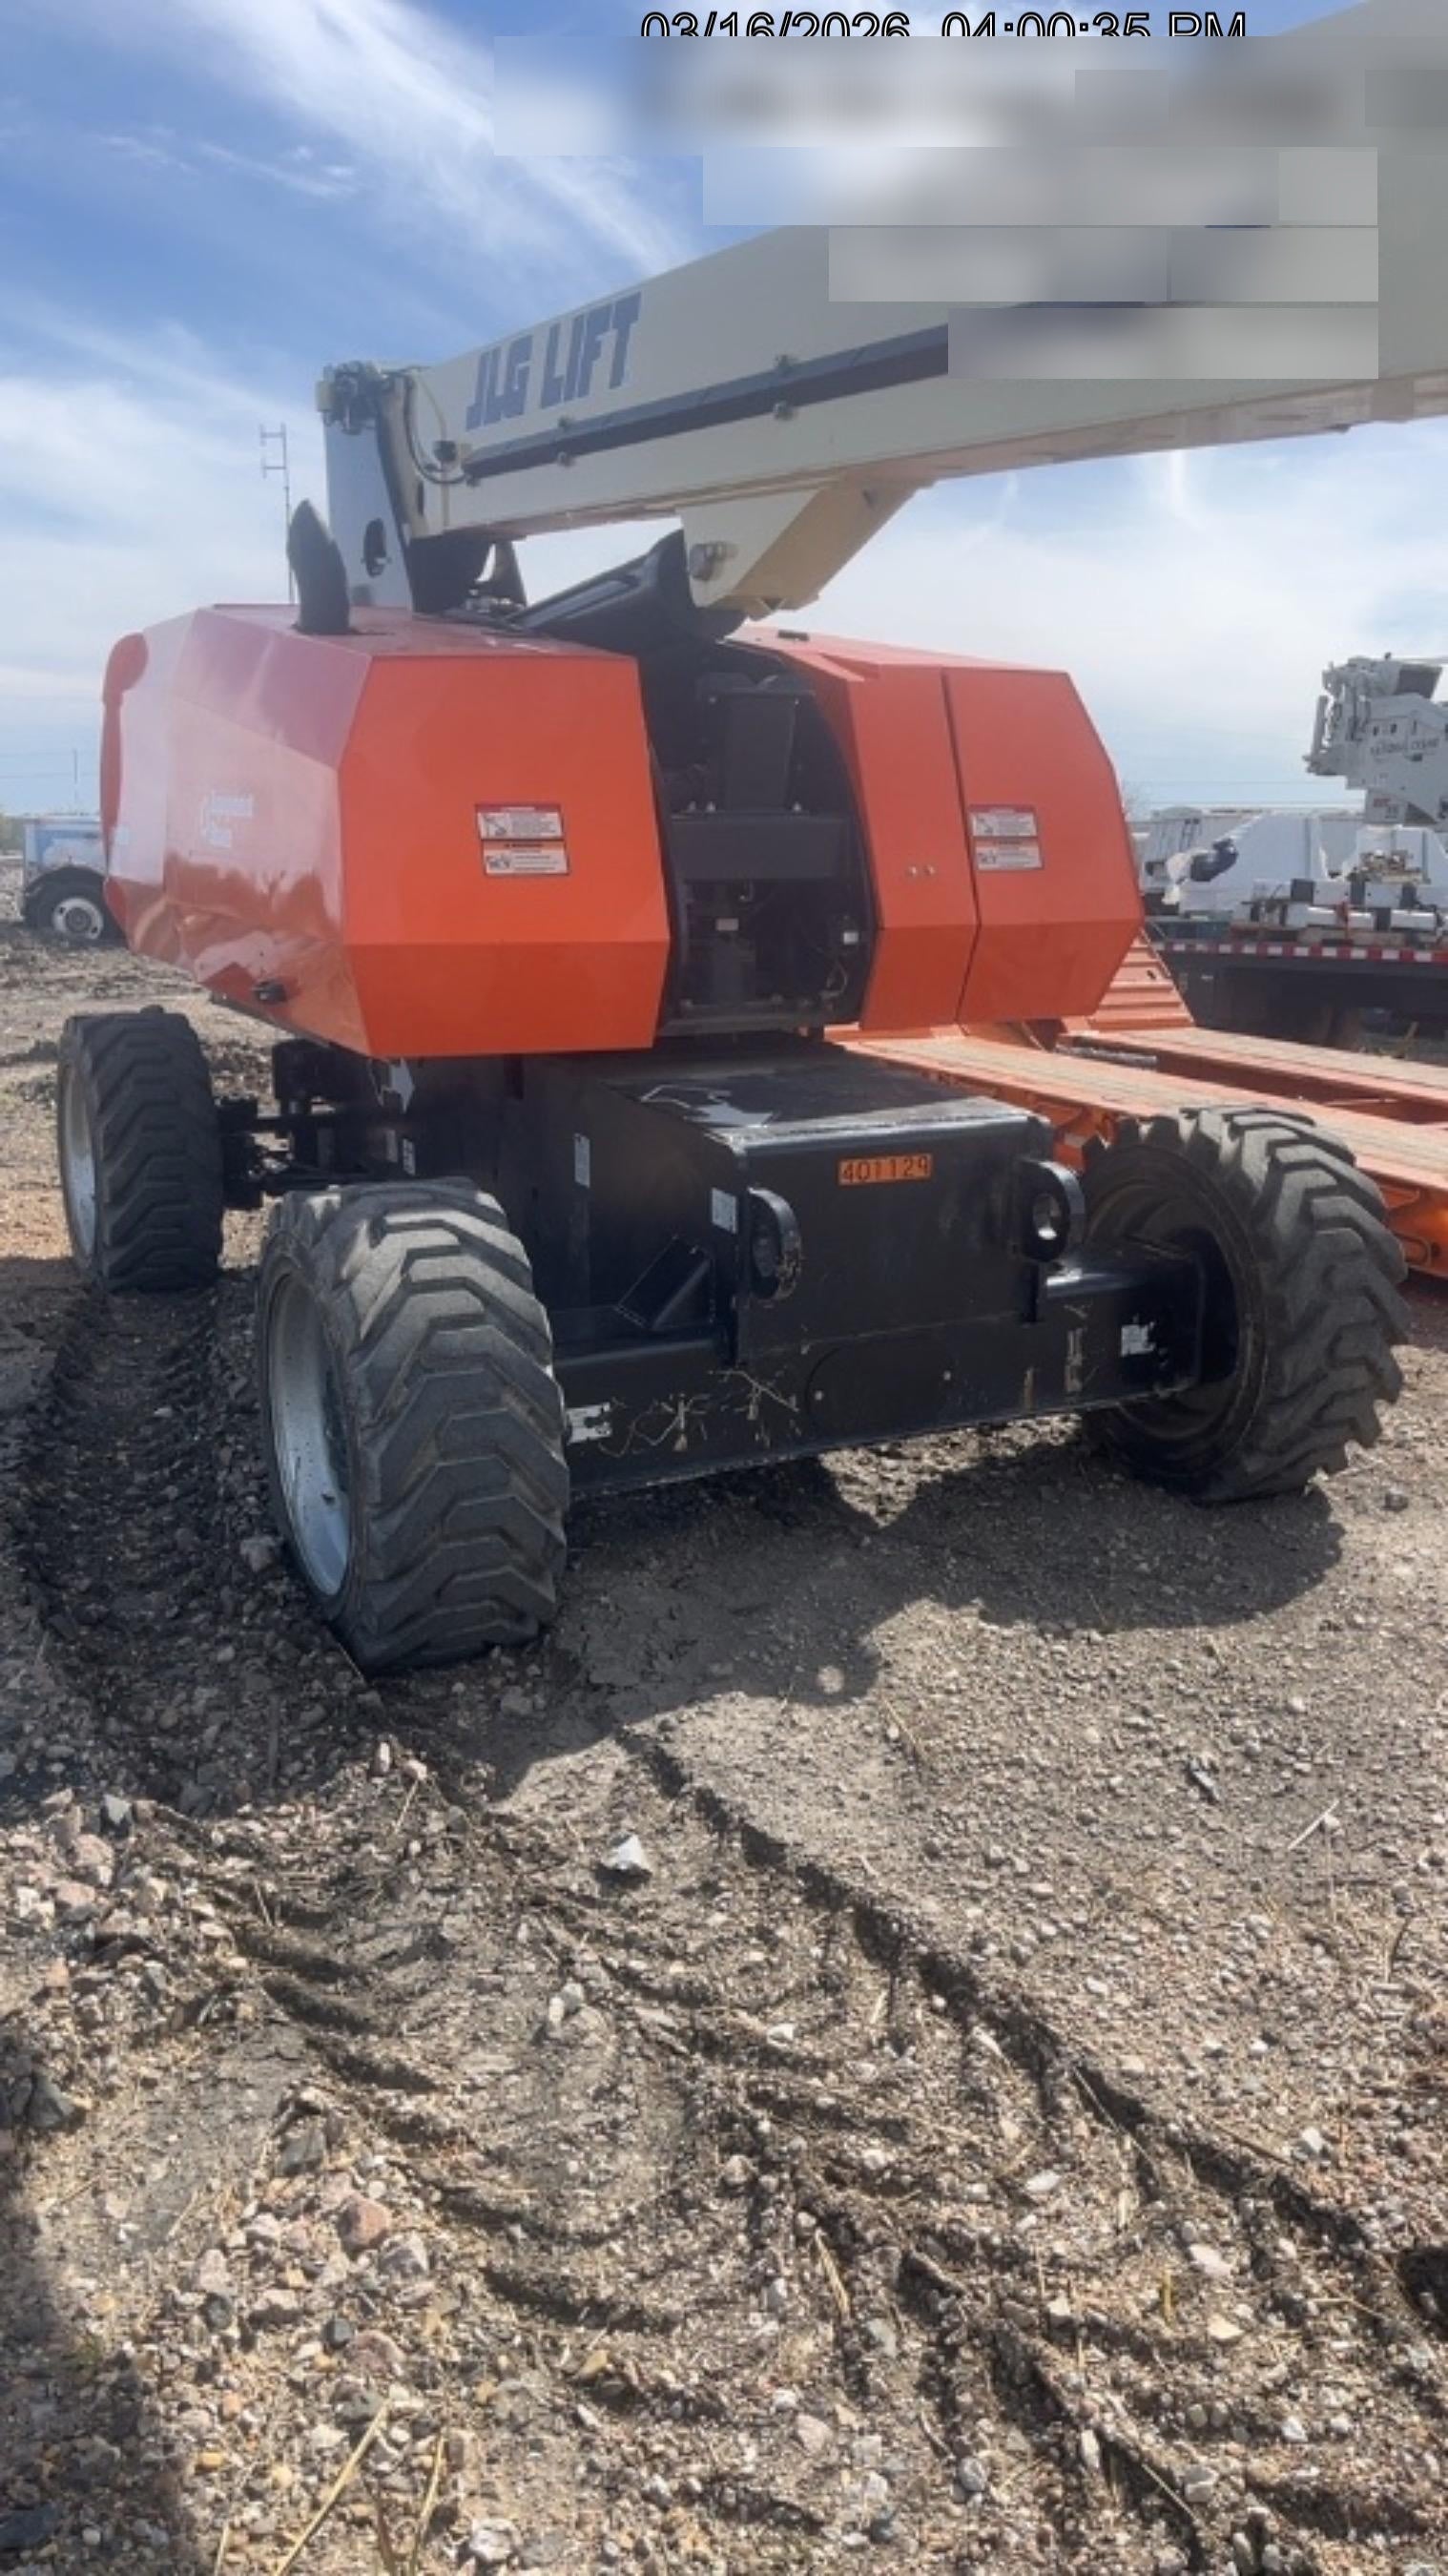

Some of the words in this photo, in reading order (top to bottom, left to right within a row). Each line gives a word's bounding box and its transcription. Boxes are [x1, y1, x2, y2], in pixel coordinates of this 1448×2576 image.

[465, 335, 532, 432] JLG
[540, 291, 641, 409] LIFT
[843, 1155, 928, 1183] 401129
